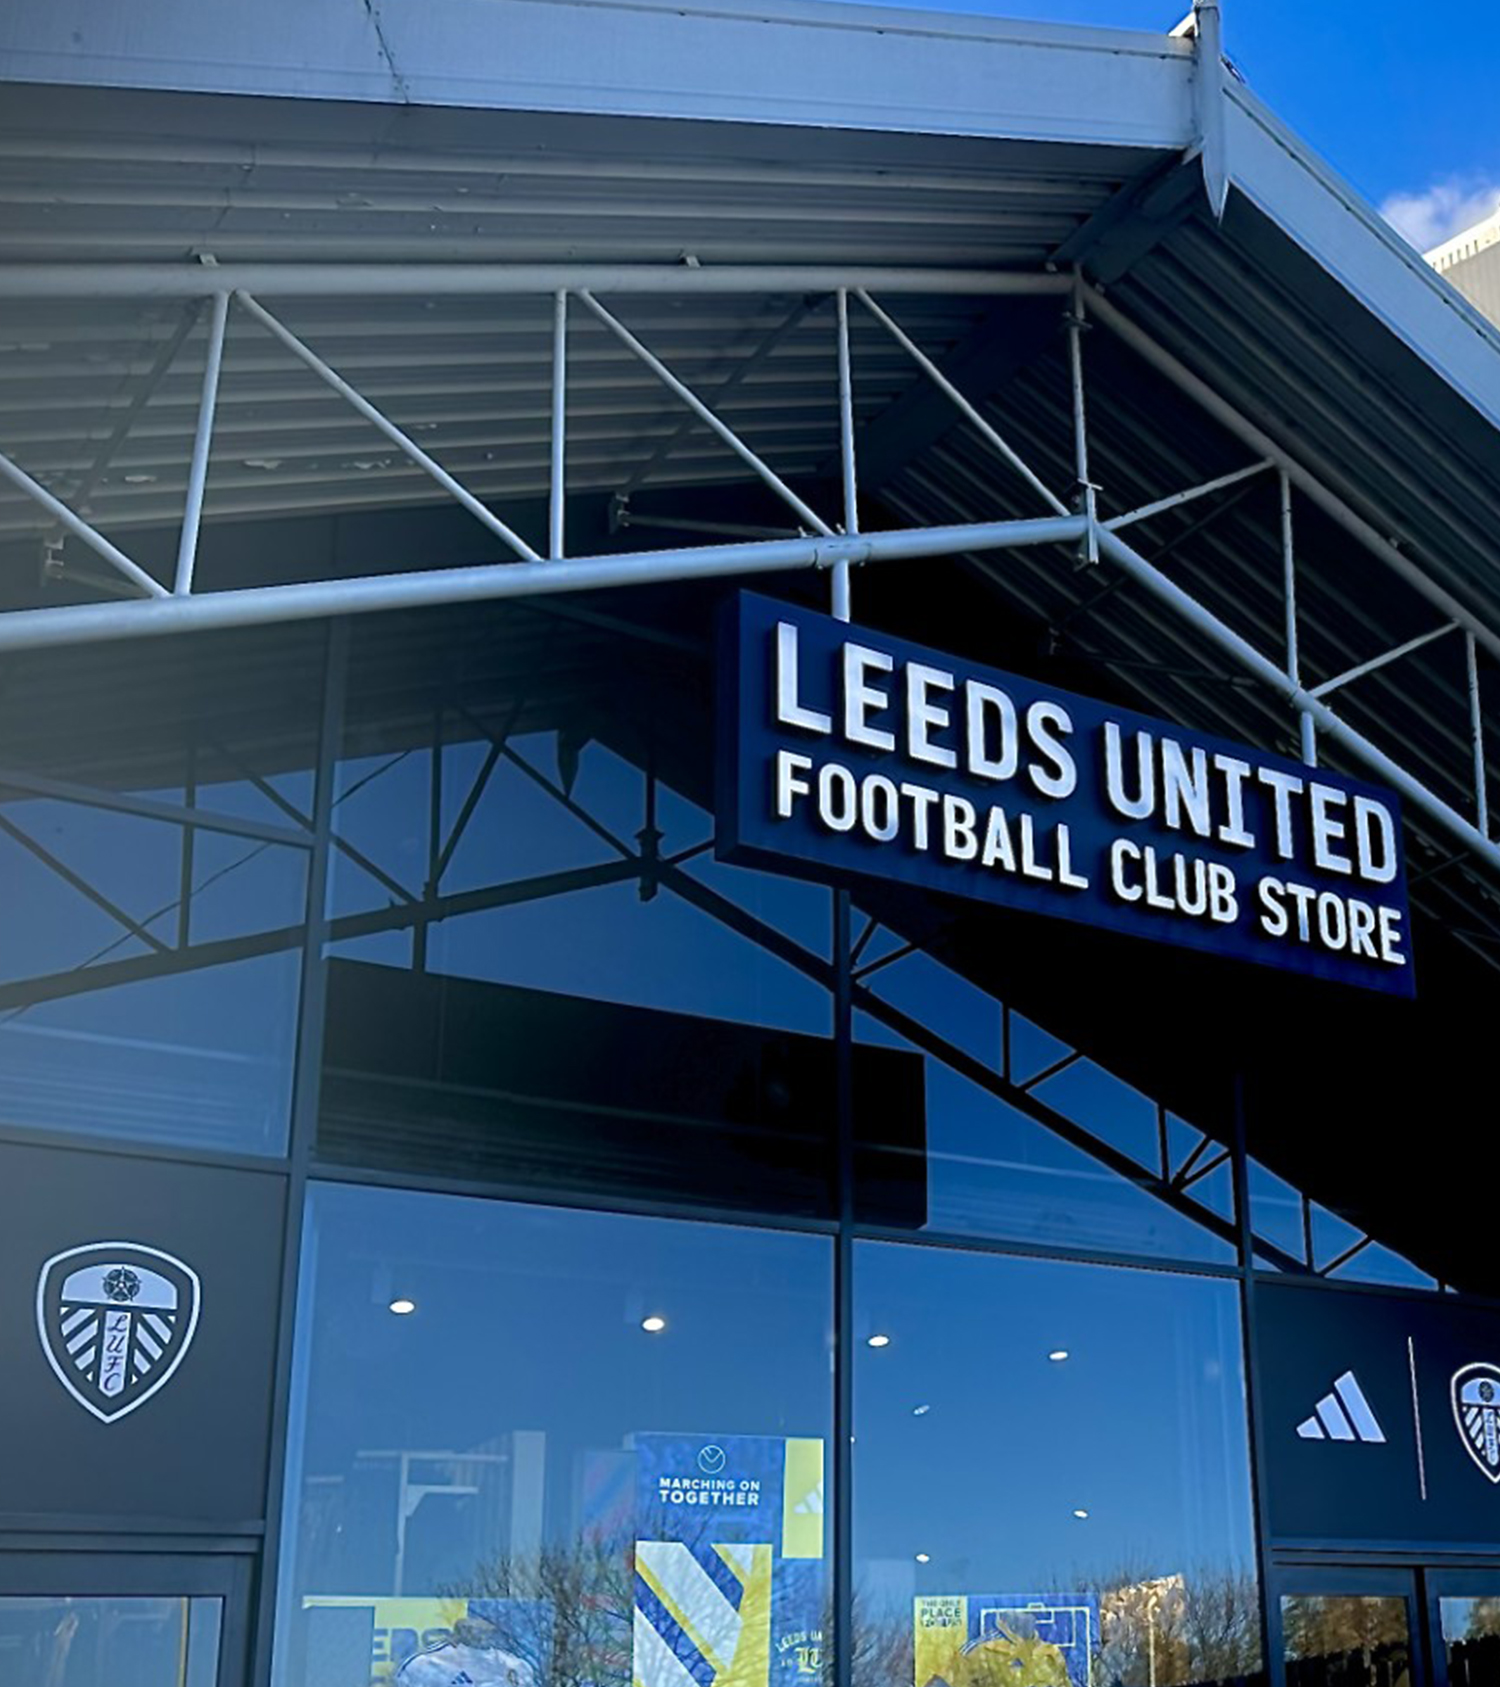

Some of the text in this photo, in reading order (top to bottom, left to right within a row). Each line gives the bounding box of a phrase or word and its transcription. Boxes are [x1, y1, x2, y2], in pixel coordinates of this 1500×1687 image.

[776, 620, 1398, 885] LEEDS UNITED
[776, 750, 1406, 965] FOOTBALL CLUB STORE
[104, 1315, 128, 1391] LUFC
[659, 1478, 760, 1491] MARCHING ON
[659, 1490, 759, 1505] TOGETHER
[921, 1608, 961, 1617] PLACE
